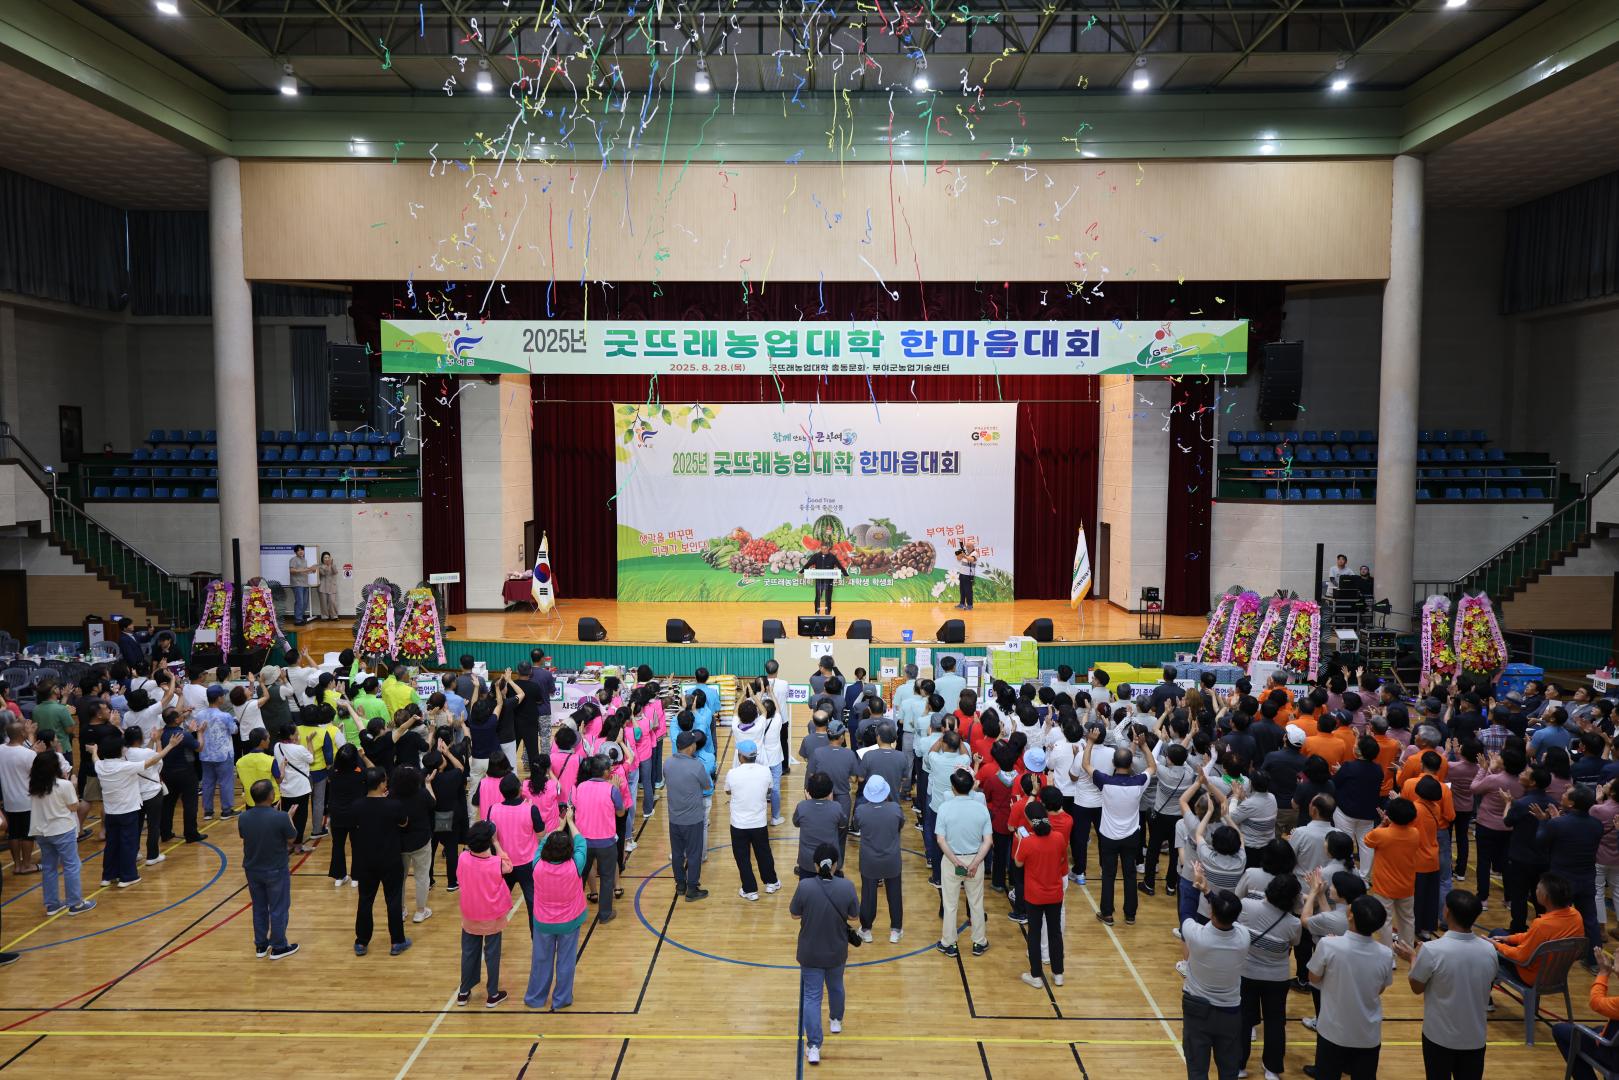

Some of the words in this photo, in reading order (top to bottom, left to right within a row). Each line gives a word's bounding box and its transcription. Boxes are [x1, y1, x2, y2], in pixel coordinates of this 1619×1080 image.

[523, 328, 587, 353] 2025년
[604, 329, 885, 358] 굿뜨래농업대학
[900, 329, 1100, 358] 한마음대회
[670, 363, 698, 371] 2025.
[872, 363, 950, 372] 부여군농업기술센터
[672, 452, 708, 474] 2025년
[713, 450, 853, 476] 굿뜨래농업대학
[859, 450, 959, 475] 한마음대회
[640, 531, 665, 545] 생각을
[668, 528, 694, 540] 바꾸면
[926, 524, 965, 538] 부여농업
